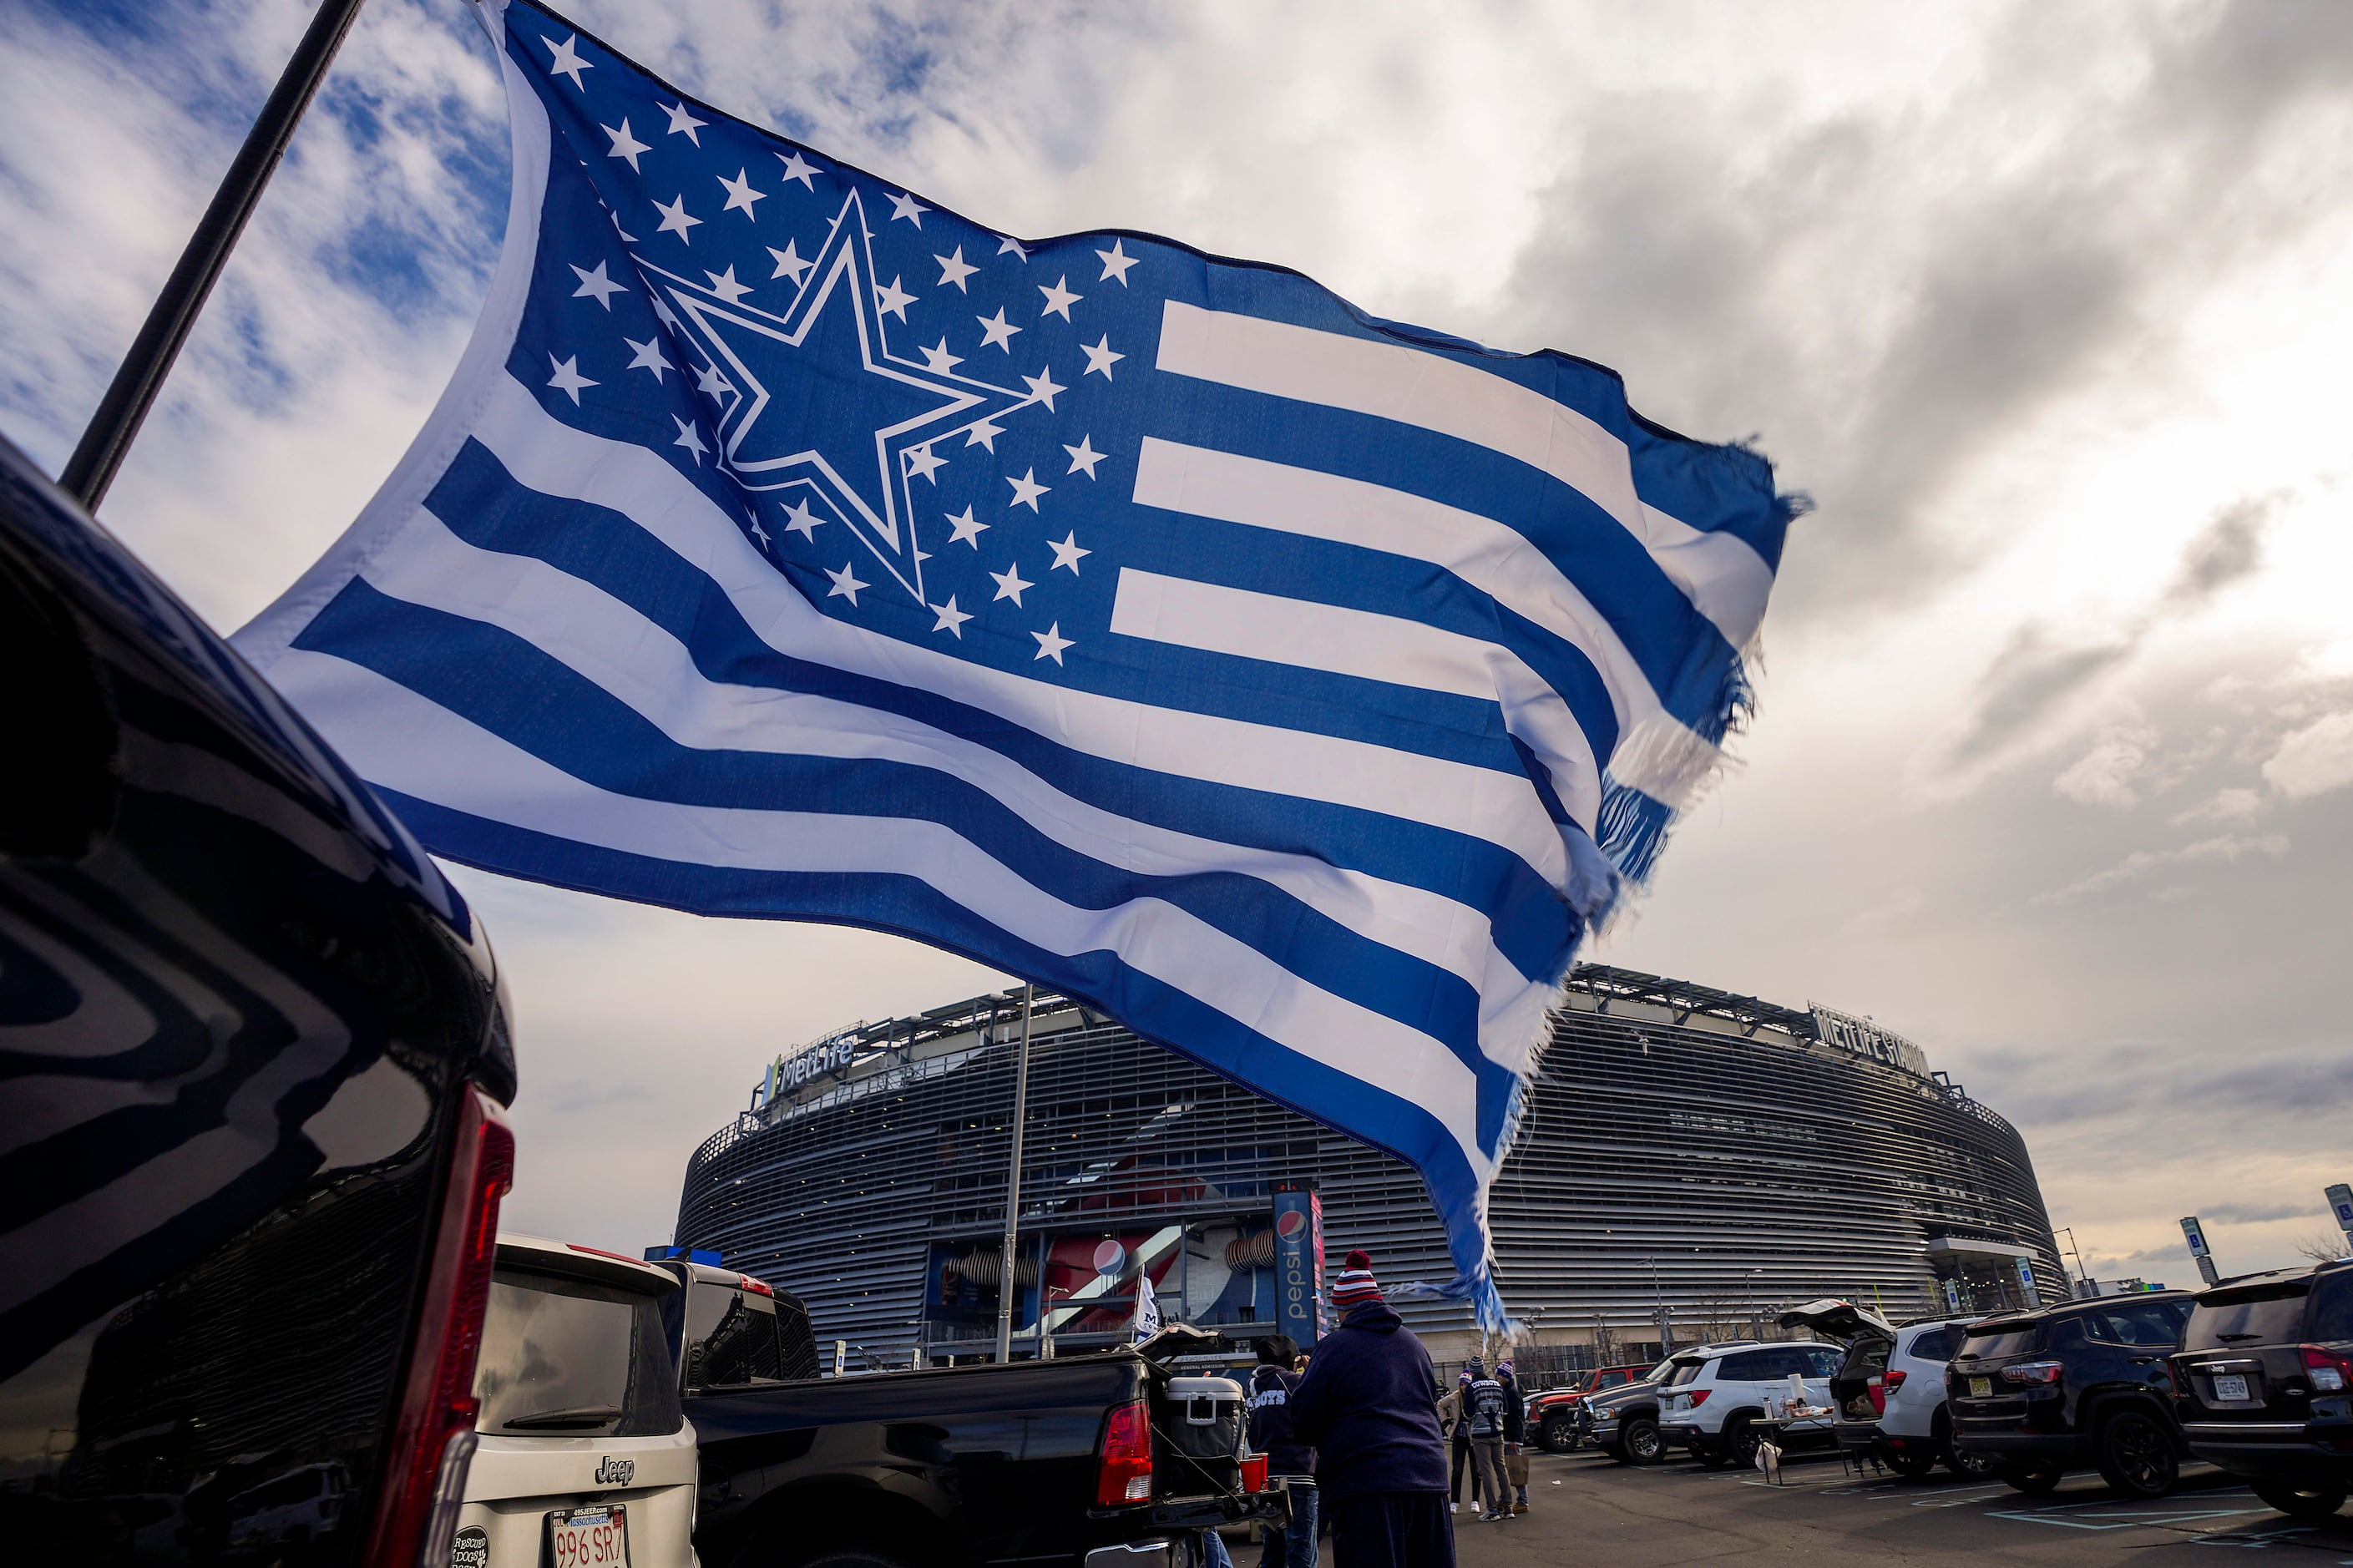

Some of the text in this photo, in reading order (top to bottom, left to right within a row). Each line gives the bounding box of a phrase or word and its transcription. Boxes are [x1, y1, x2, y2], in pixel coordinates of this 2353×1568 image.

[1814, 1006, 1885, 1060] METLIFE
[780, 1034, 854, 1090] MetLife
[1283, 1252, 1308, 1319] pepsi
[2210, 1365, 2226, 1373] Jeep
[595, 1456, 635, 1486] Jeep
[574, 1507, 608, 1516] 495JEEP.com
[453, 1537, 486, 1550] RESCUED
[455, 1550, 478, 1562] DOGS
[557, 1524, 623, 1568] 996 SR7
